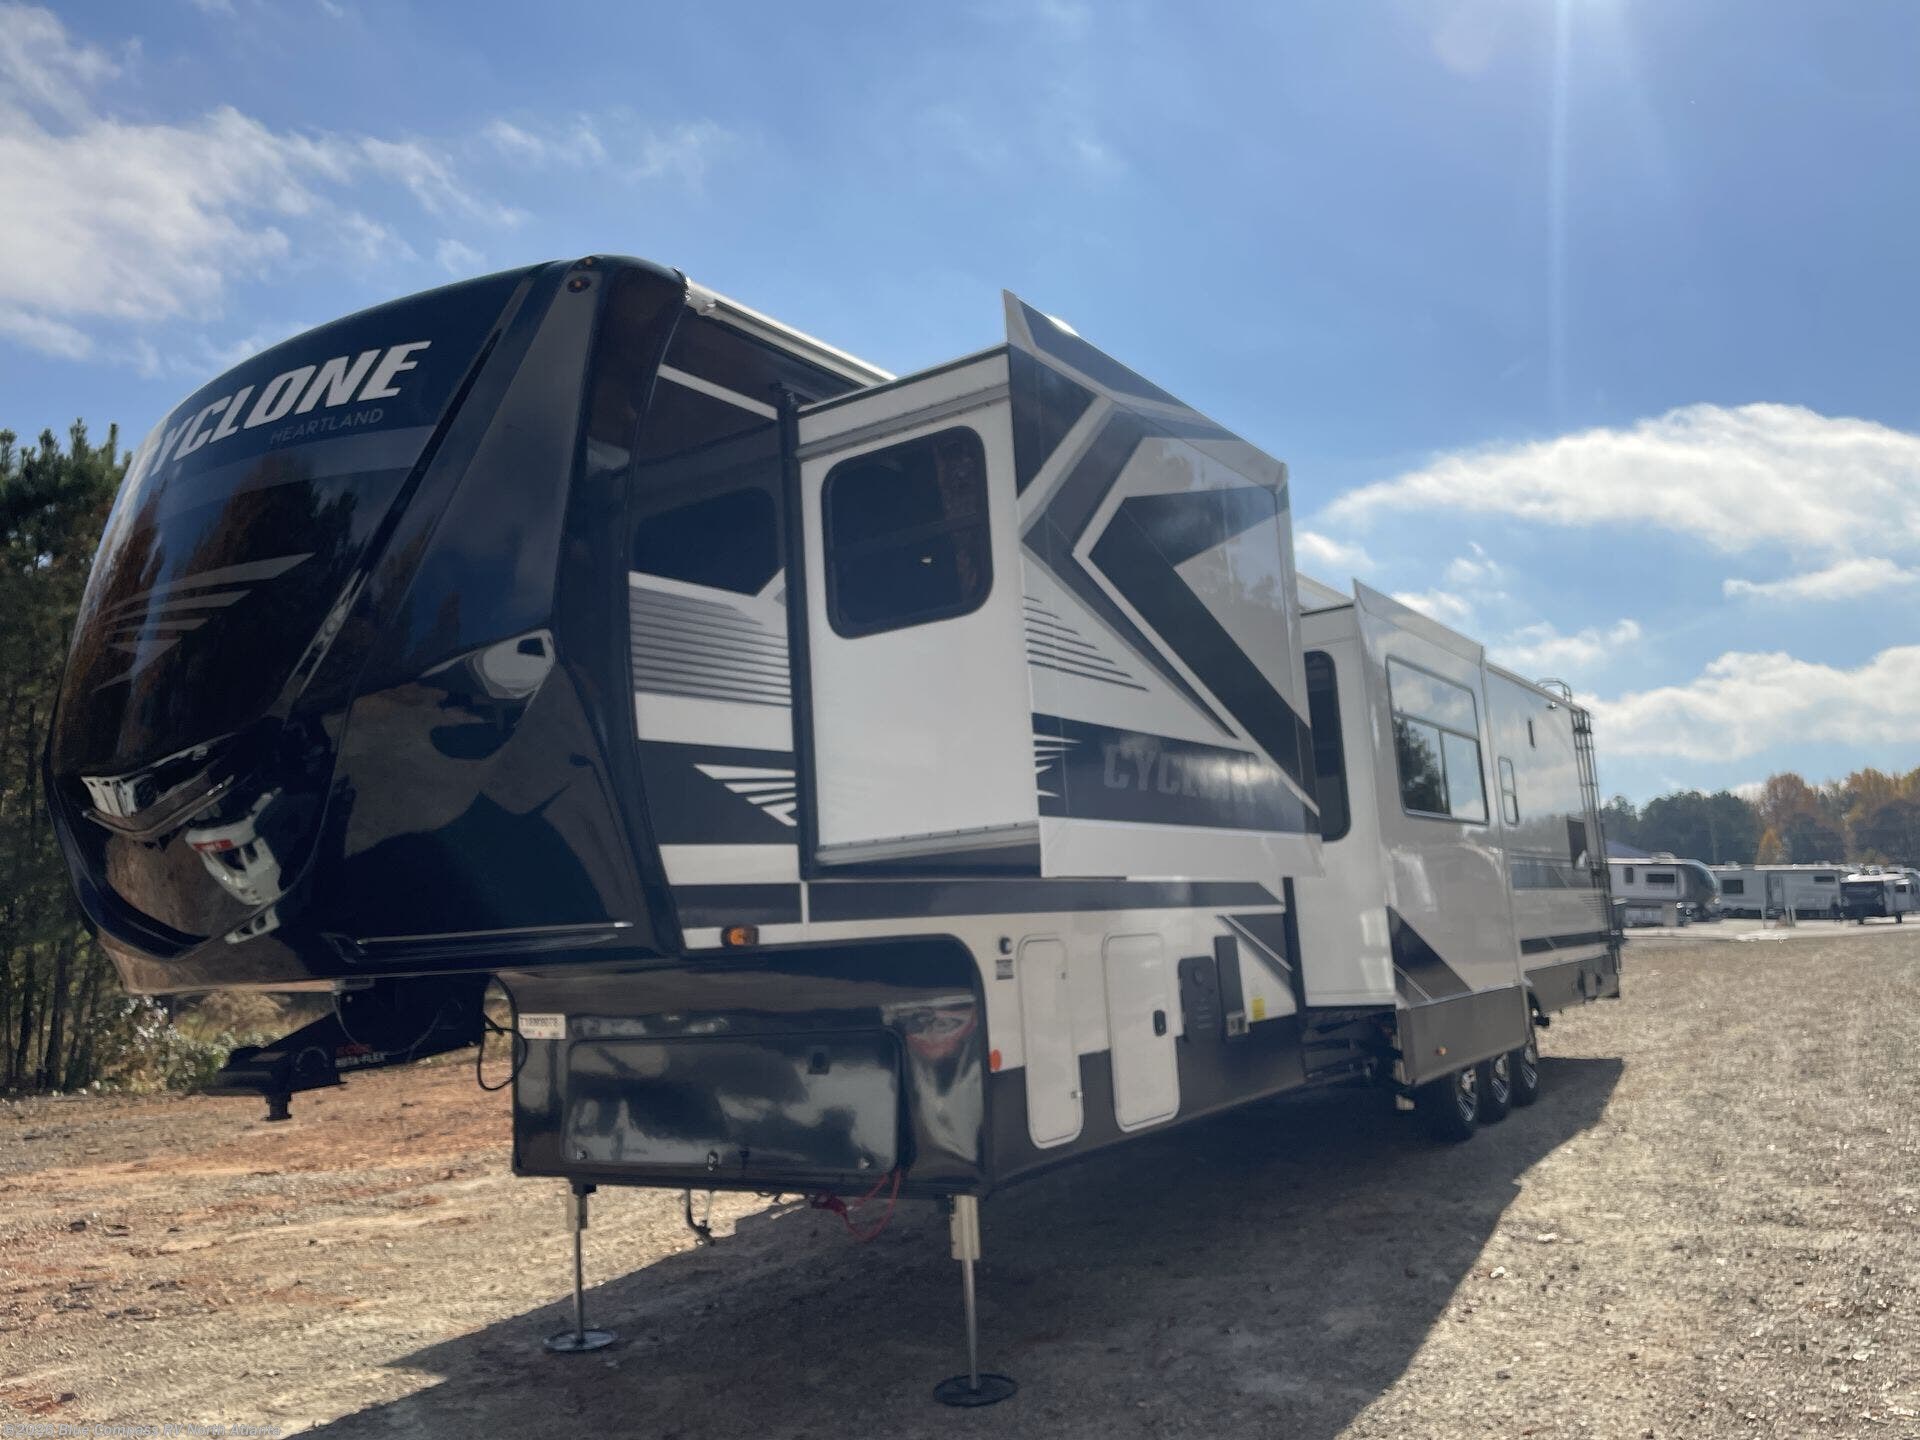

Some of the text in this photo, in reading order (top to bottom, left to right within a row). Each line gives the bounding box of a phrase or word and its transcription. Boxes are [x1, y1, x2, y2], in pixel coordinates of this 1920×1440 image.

[143, 340, 432, 478] YCLONE
[270, 407, 384, 445] HEARTLAND
[1103, 742, 1277, 804] CYCLON
